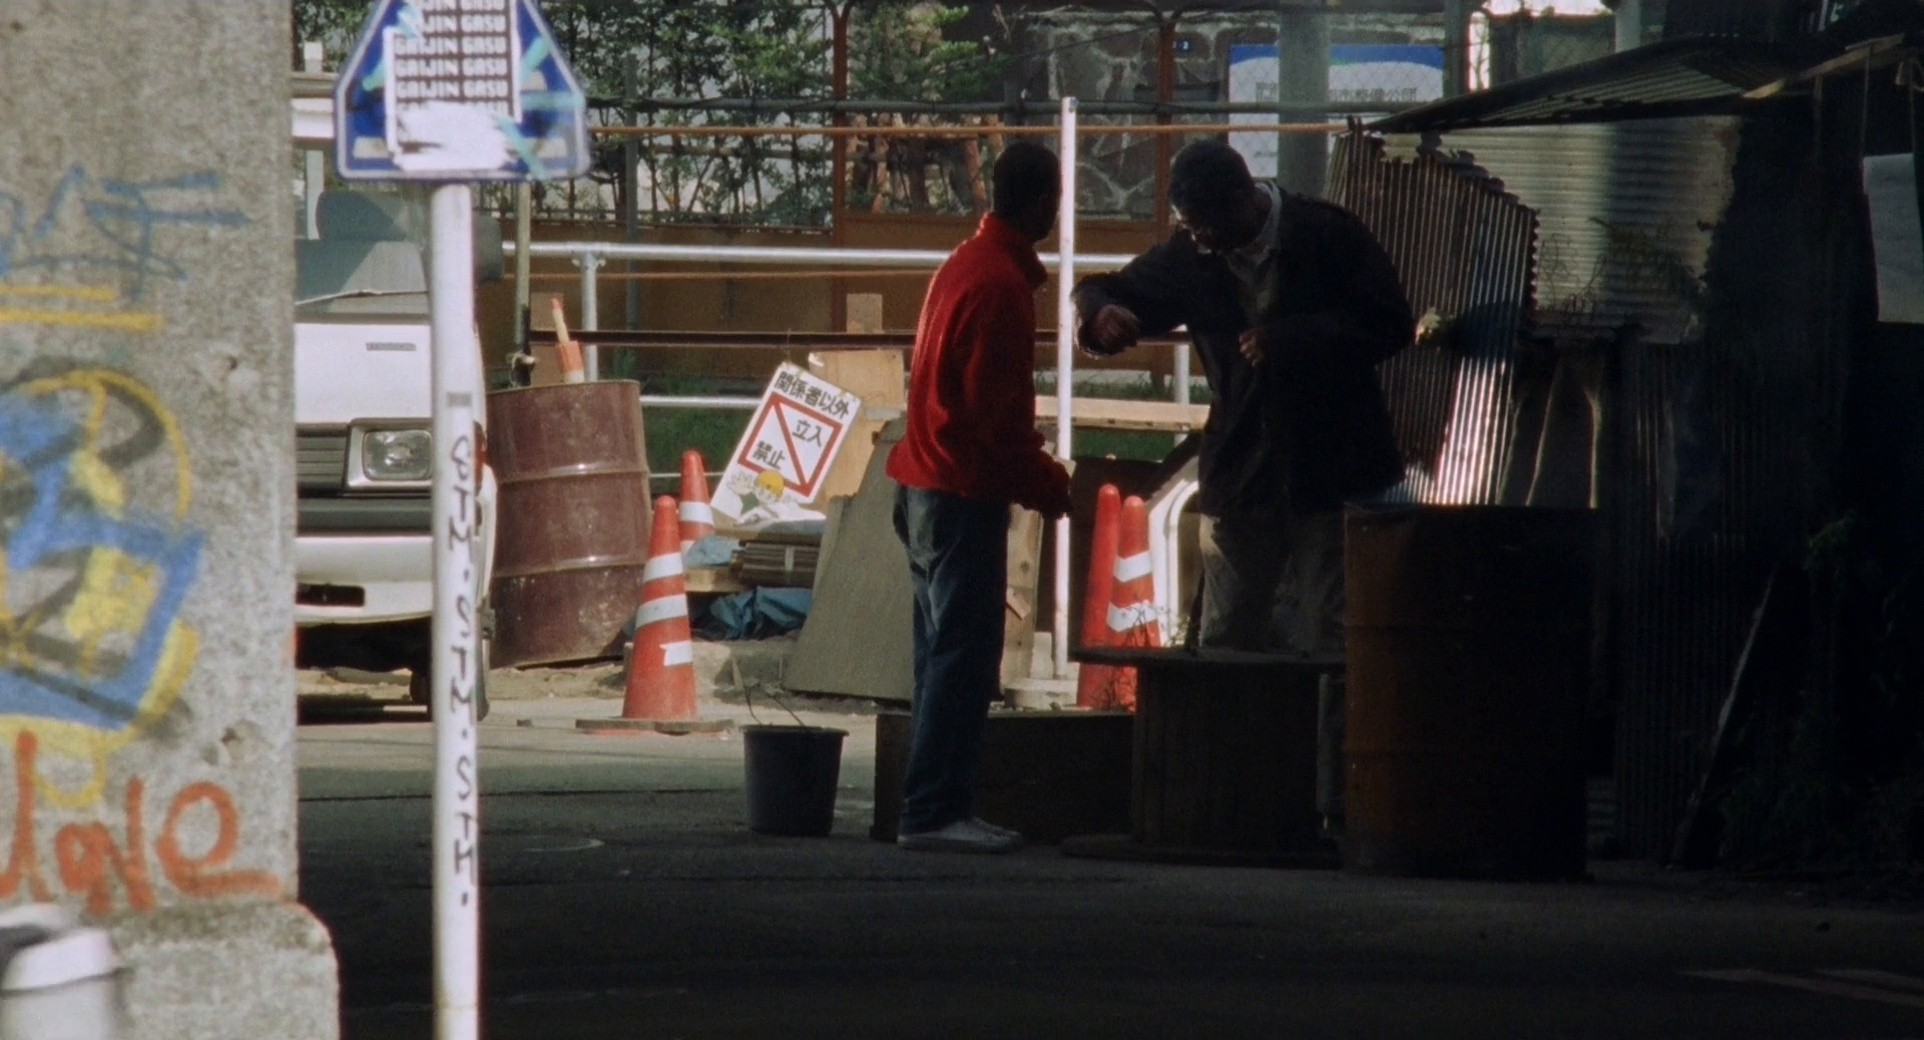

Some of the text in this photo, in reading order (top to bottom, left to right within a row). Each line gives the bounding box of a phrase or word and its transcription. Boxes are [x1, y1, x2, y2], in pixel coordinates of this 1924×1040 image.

[773, 371, 849, 419] 関係者以外
[792, 419, 823, 448] 立入
[752, 439, 787, 470] 禁止
